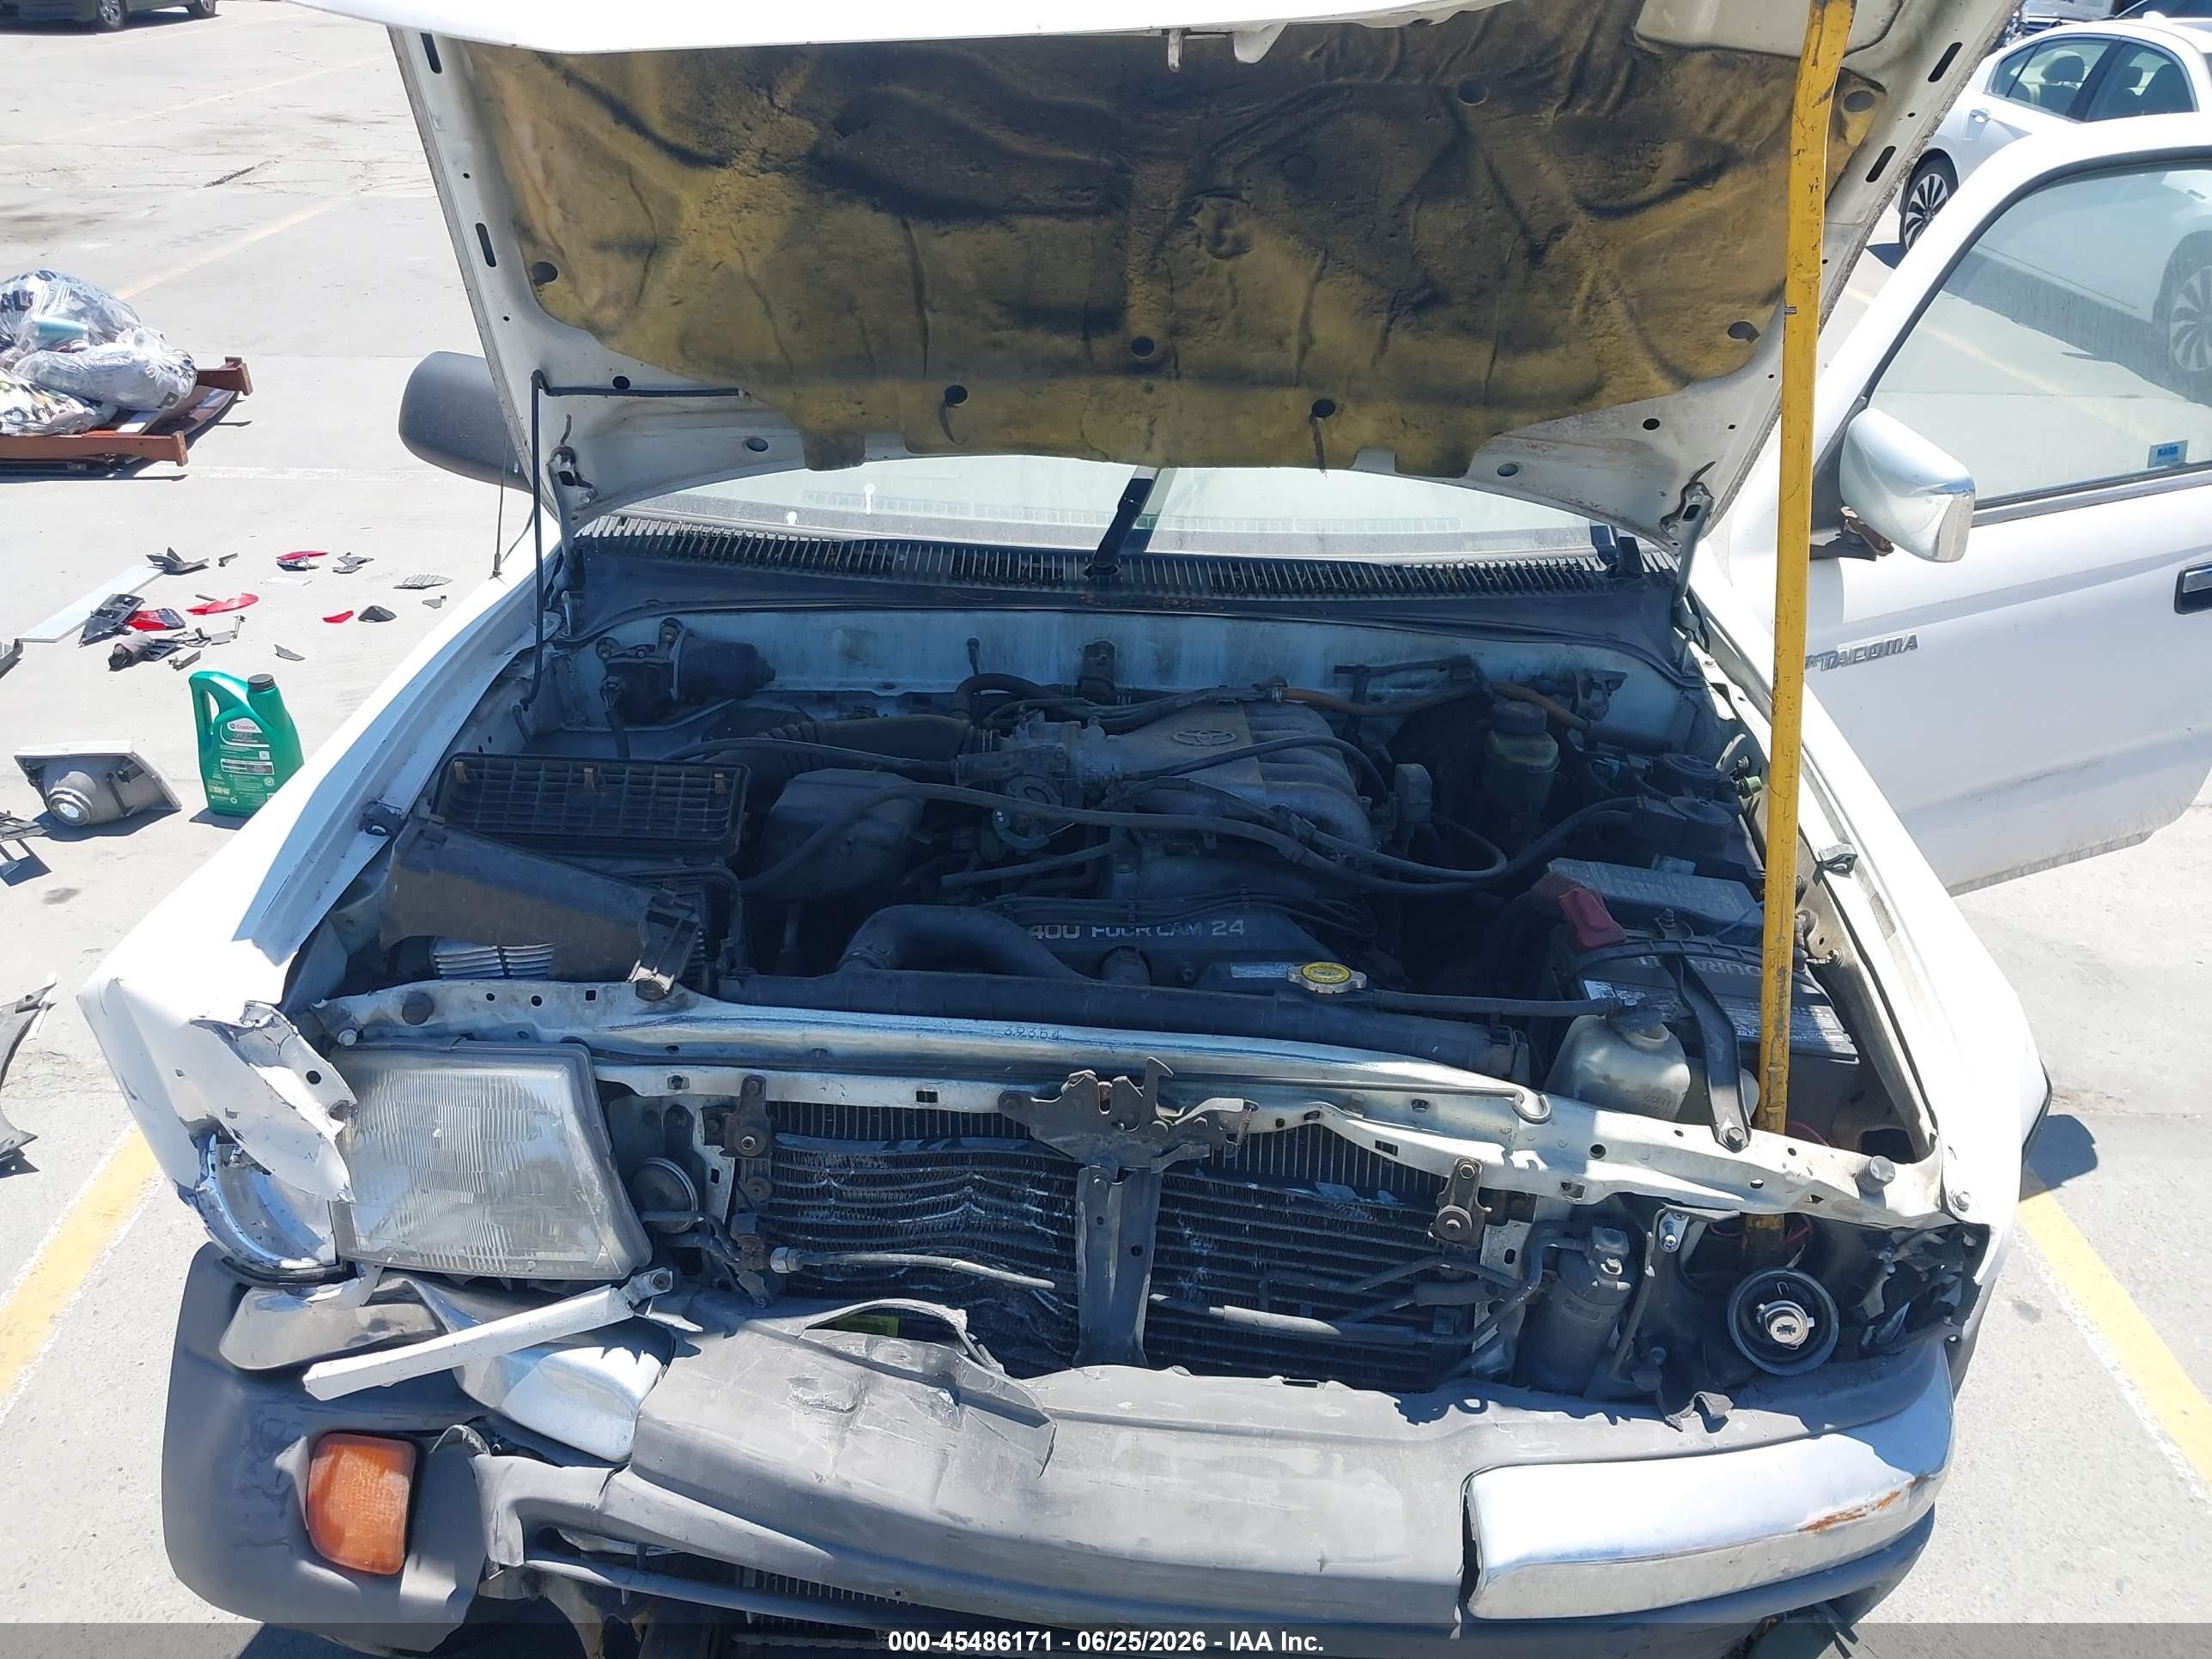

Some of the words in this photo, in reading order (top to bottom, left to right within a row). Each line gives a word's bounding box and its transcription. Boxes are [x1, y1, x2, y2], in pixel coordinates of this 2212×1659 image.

[1819, 632, 1918, 672] TACOMA
[1030, 925, 1080, 939] 400
[1212, 919, 1245, 936] 24
